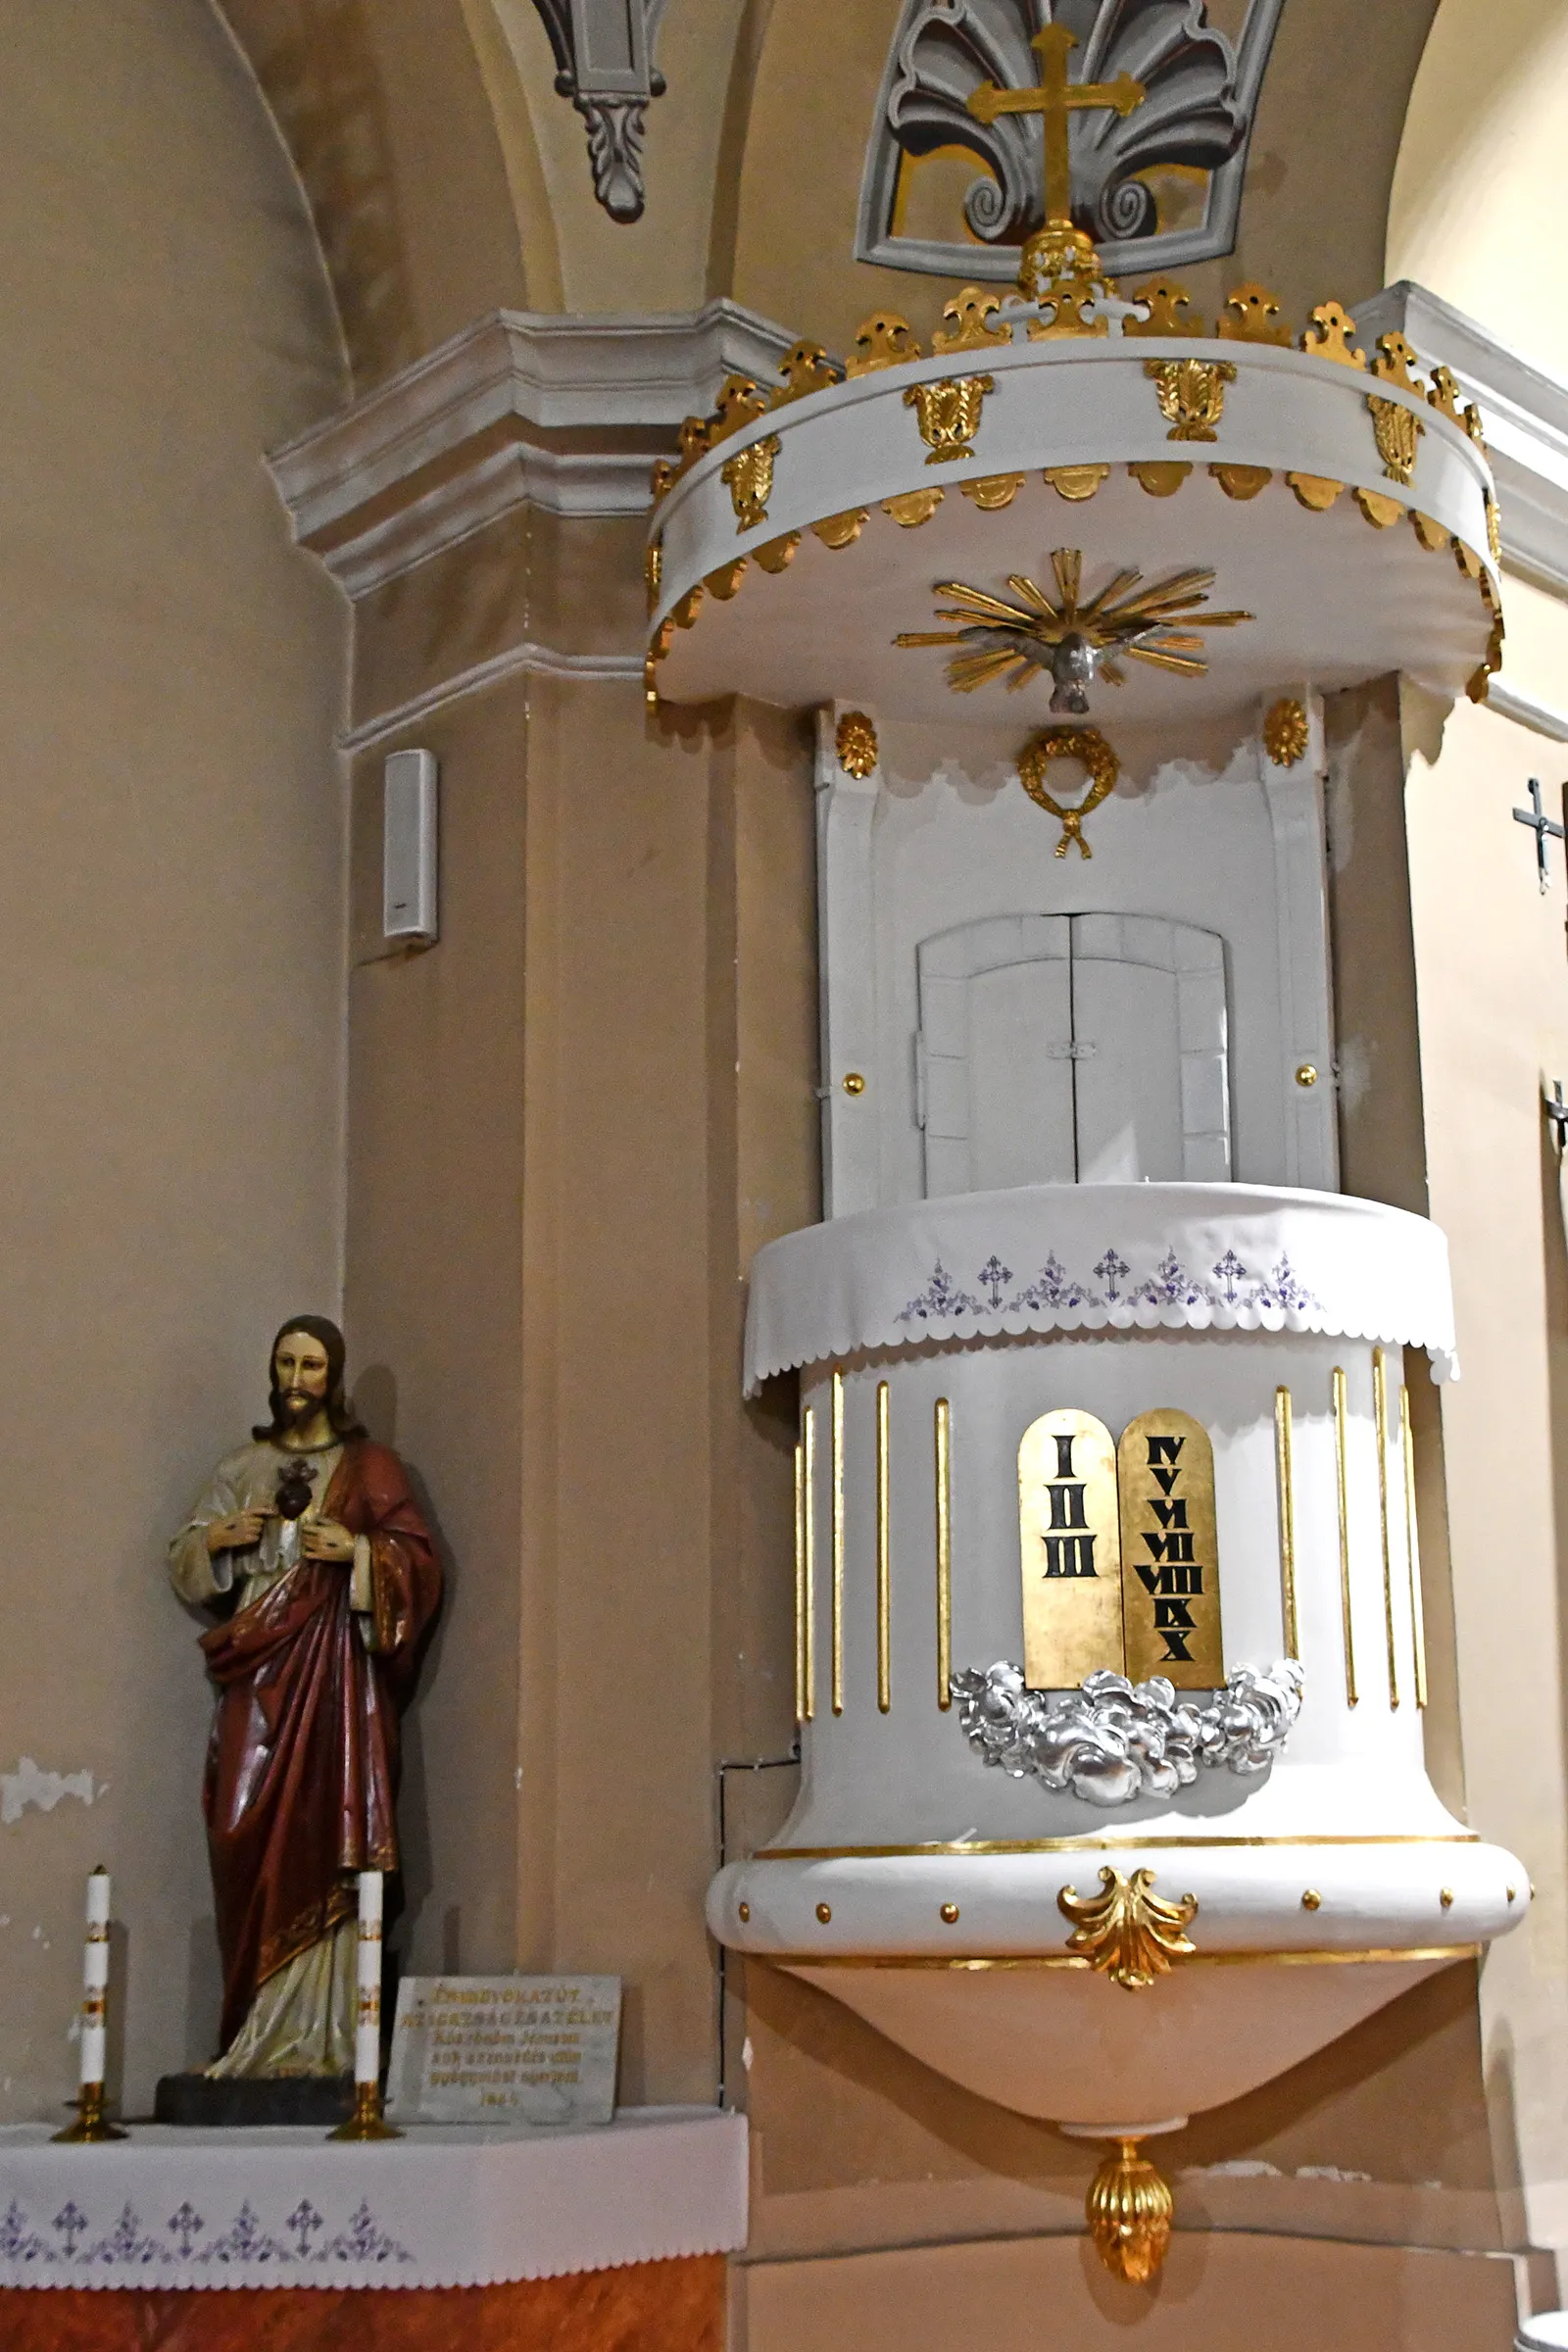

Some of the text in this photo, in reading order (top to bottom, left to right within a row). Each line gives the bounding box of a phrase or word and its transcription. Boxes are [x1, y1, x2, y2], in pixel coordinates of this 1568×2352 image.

[1052, 1435, 1077, 1479] I
[1146, 1436, 1187, 1465] IV
[1150, 1468, 1182, 1496] V
[1043, 1484, 1091, 1530] II
[1147, 1498, 1190, 1529] VI
[1041, 1535, 1100, 1578] III
[1140, 1533, 1195, 1562] VII
[1133, 1565, 1203, 1594] VIII
[1153, 1598, 1197, 1628] IX
[1158, 1630, 1196, 1662] X
